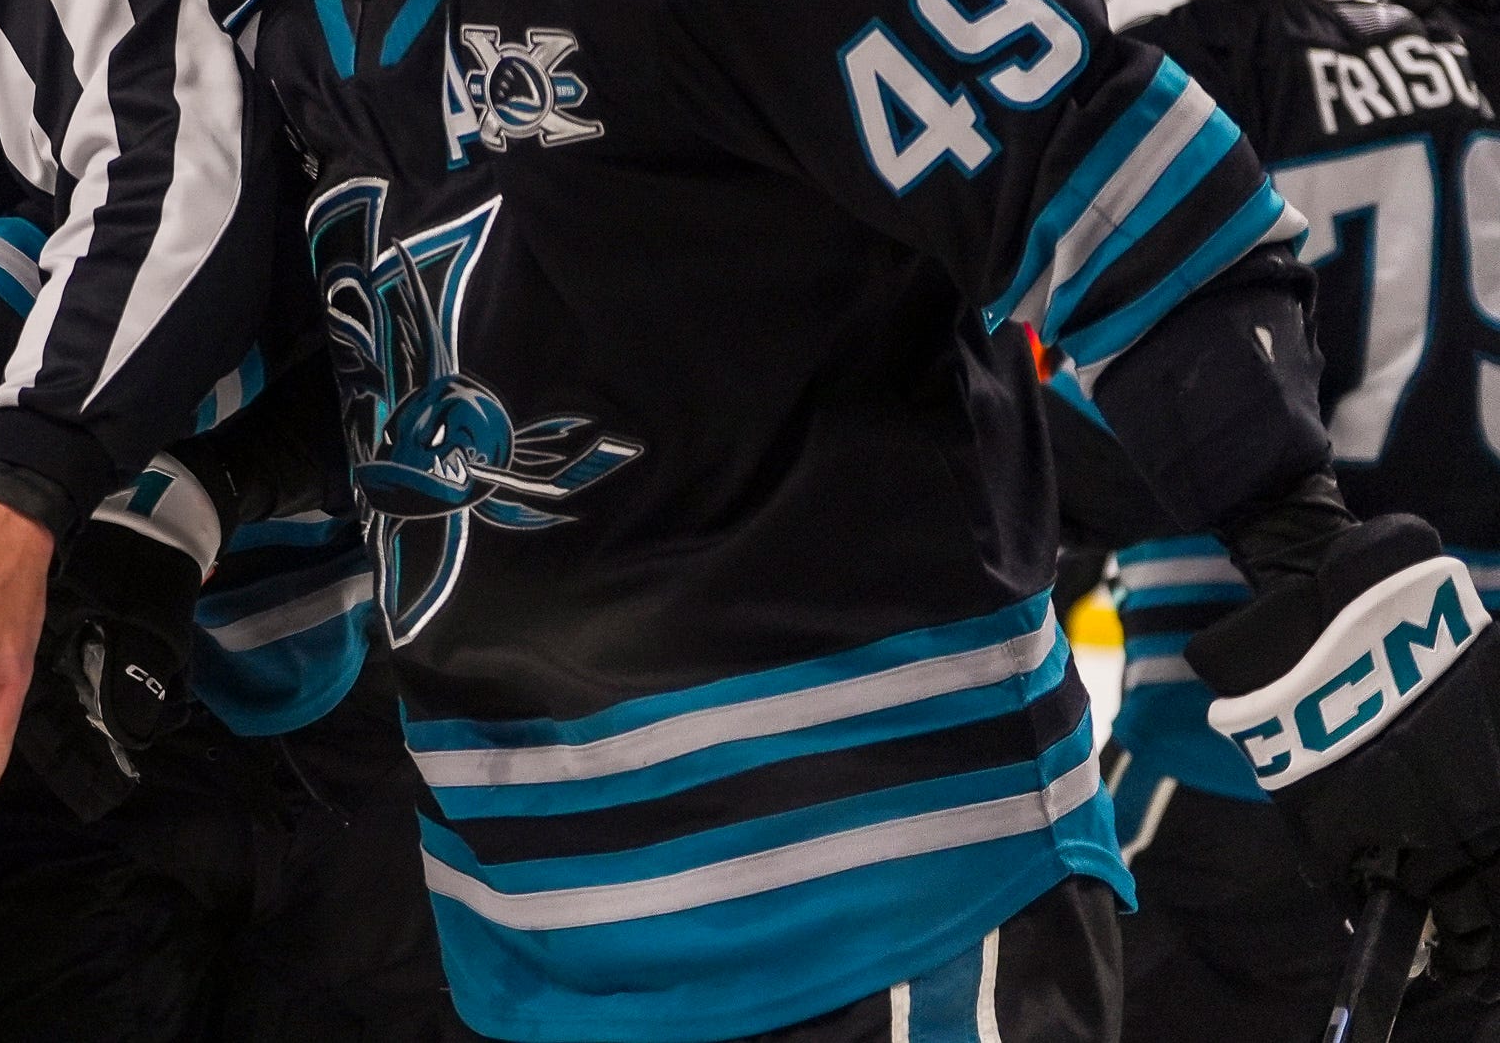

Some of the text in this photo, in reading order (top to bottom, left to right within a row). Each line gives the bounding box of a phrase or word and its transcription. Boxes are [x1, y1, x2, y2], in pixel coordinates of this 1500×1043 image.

[1307, 34, 1495, 135] FRISC
[1269, 131, 1500, 468] 7
[1230, 574, 1473, 779] CCM
